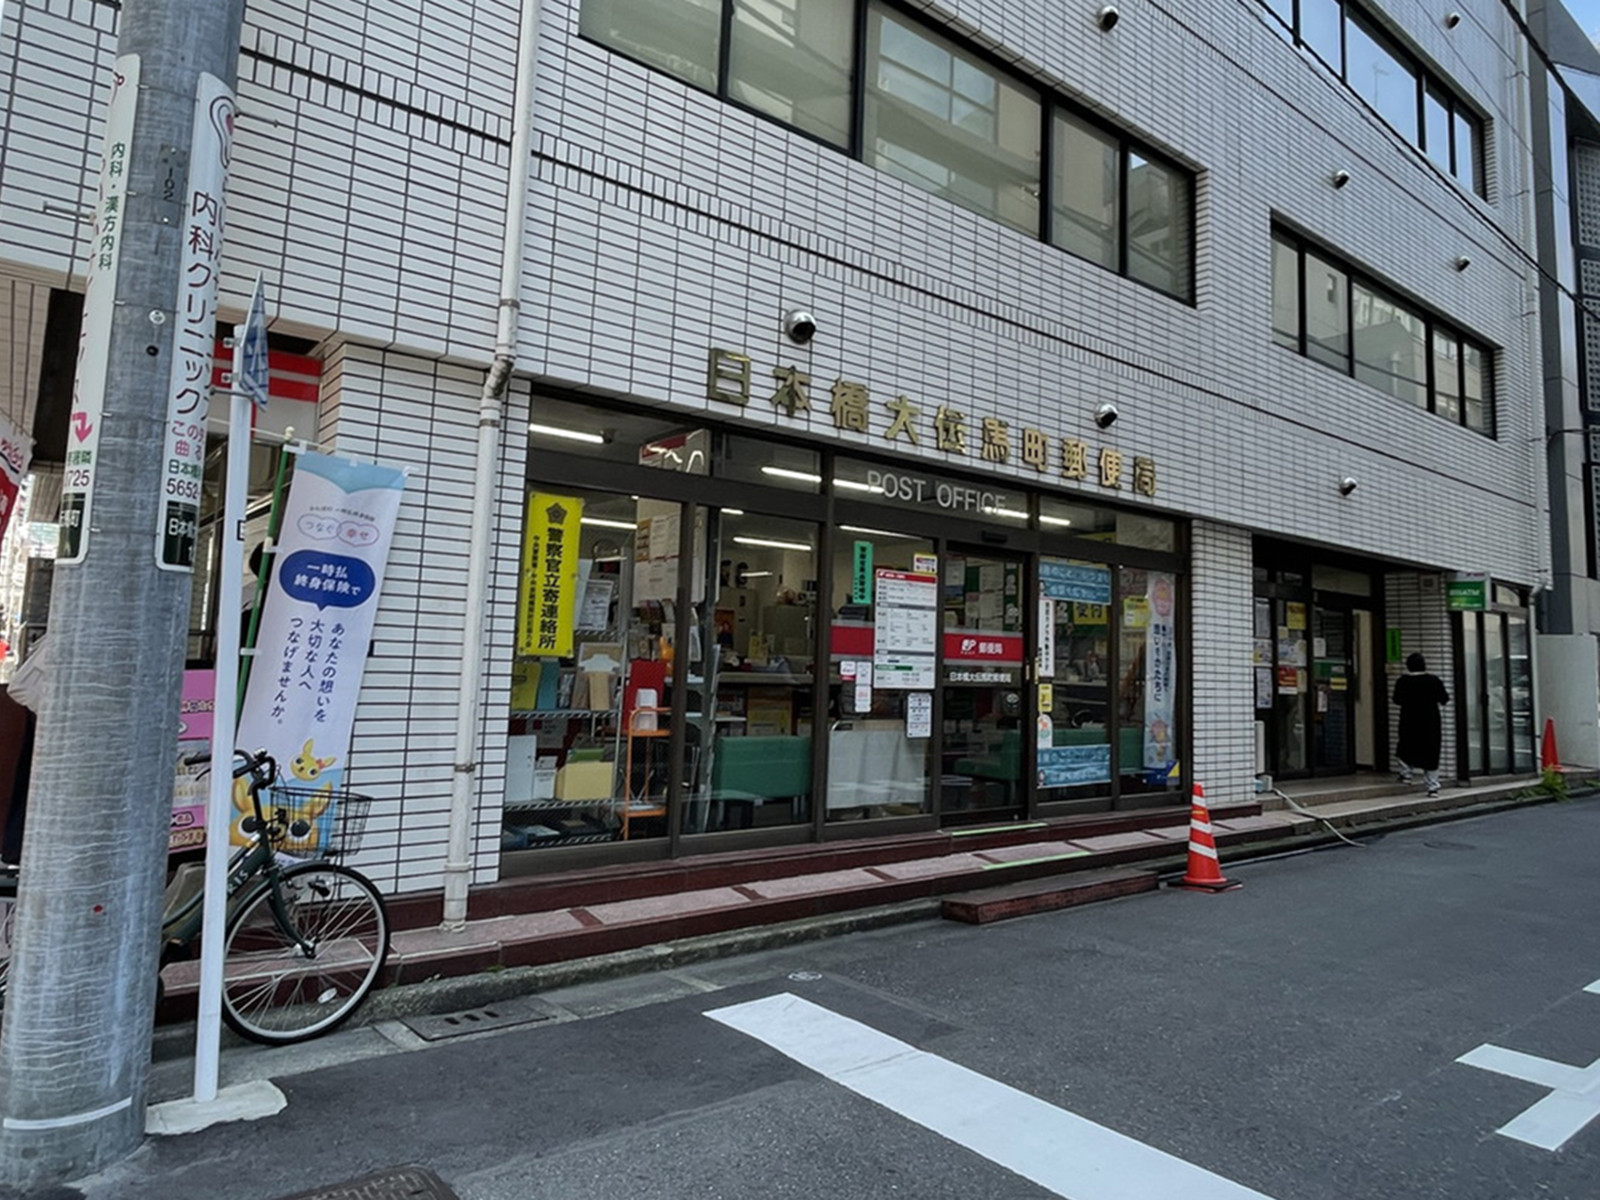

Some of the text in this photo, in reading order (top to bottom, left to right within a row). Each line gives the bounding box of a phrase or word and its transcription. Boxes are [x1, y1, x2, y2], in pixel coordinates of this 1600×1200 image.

[97, 142, 126, 270] 内科・漢方内科
[175, 191, 218, 415] 内科クリニック
[708, 347, 1156, 497] 日本橋大伝馬町郵便局
[305, 521, 369, 541] つなぐ 幸せ
[867, 470, 1006, 514] POST OFFICE
[293, 574, 361, 596] 終身保険で
[306, 564, 348, 579] 一時払
[538, 527, 564, 649] 警察官立寄連絡所
[271, 618, 303, 724] つなげませんか。
[299, 619, 325, 690] 大切な人へ
[314, 623, 345, 723] あなたの想いを
